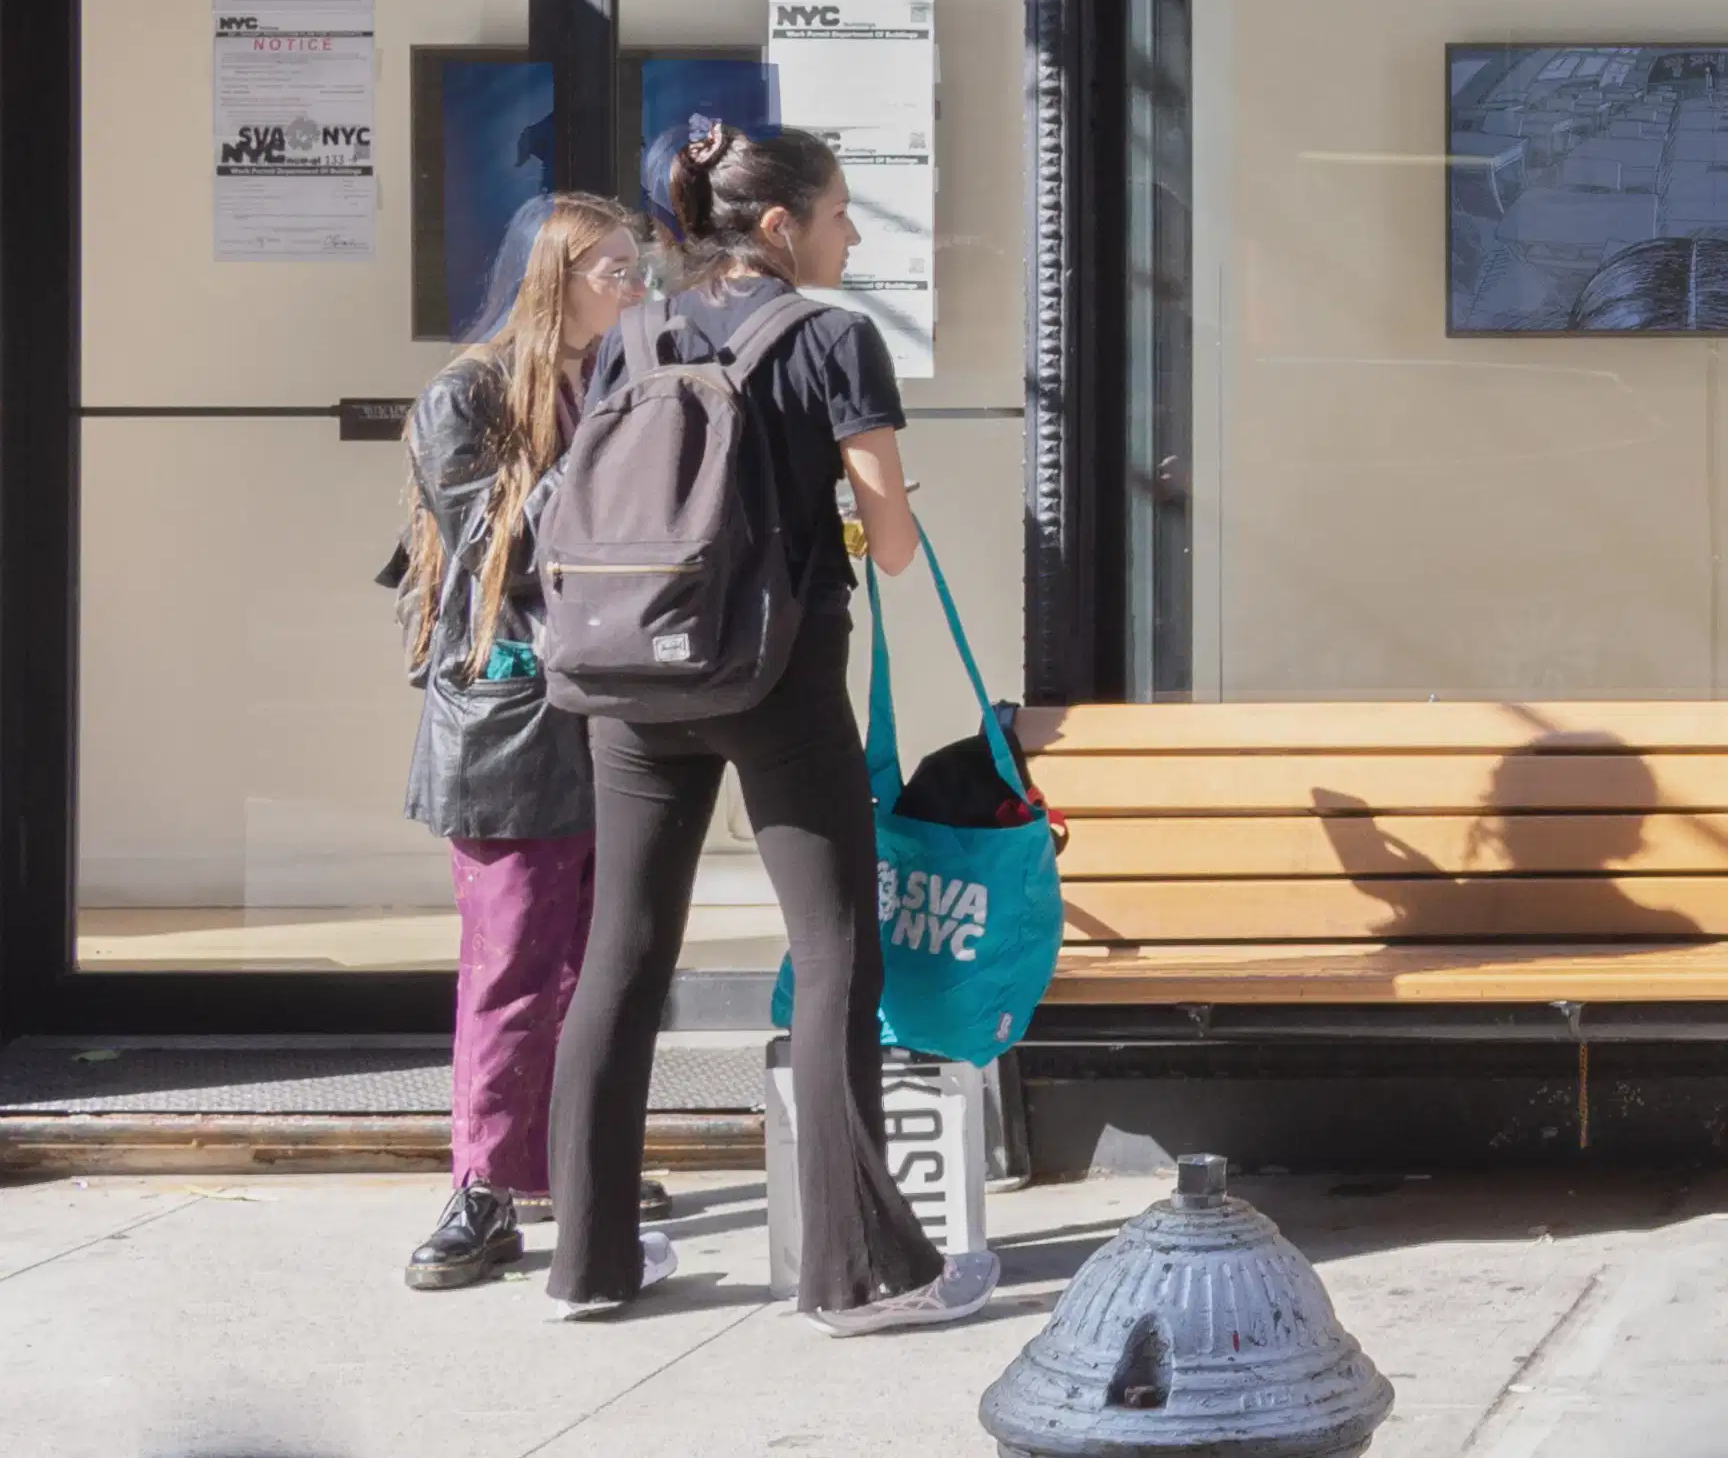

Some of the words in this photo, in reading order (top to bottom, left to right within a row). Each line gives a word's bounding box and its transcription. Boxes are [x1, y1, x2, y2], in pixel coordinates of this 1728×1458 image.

[219, 17, 257, 29] NYC
[777, 6, 840, 26] NYC
[253, 38, 332, 51] NOTICE
[239, 127, 285, 147] SVA
[322, 127, 370, 145] NYC
[902, 871, 988, 924] SVA
[891, 909, 985, 961] NYC
